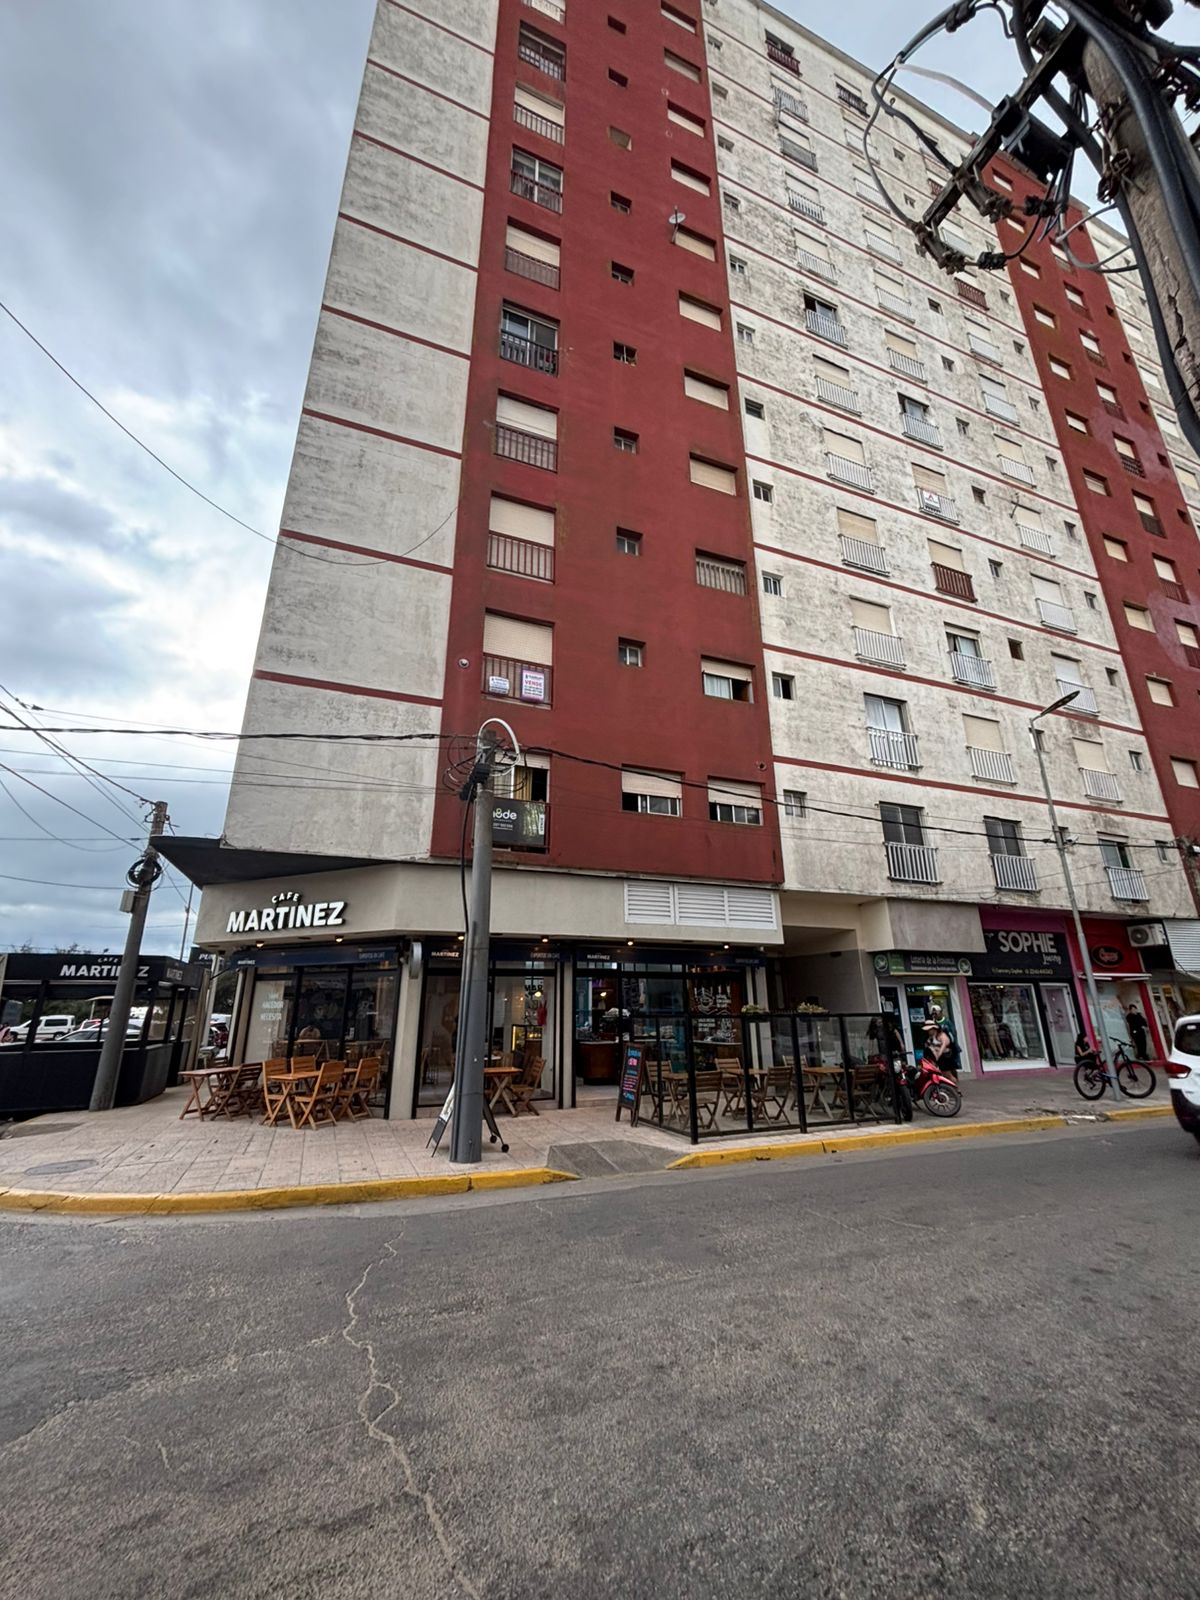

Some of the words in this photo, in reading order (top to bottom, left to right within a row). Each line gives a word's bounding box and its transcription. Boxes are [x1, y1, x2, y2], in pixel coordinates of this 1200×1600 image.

[271, 891, 300, 904] CAFE
[226, 901, 345, 933] MARTINEZ
[998, 931, 1058, 953] SOPHIE
[60, 965, 150, 977] MARTIZ
